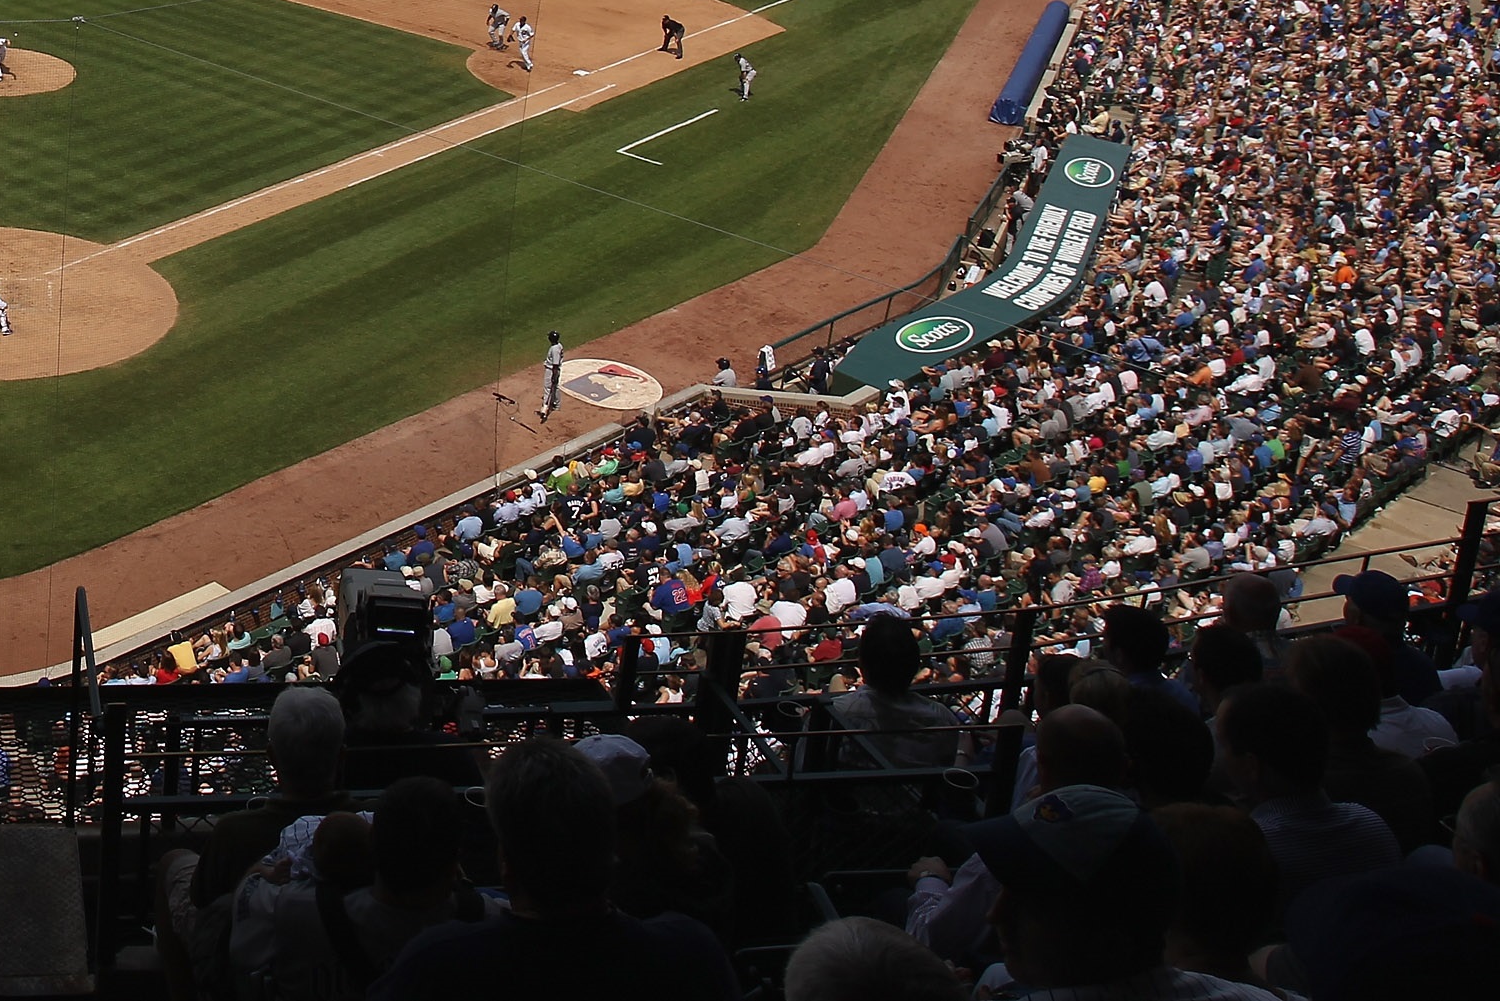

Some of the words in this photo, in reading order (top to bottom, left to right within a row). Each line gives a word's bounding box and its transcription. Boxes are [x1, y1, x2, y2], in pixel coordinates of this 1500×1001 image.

[1033, 203, 1068, 236] FRIENDLY
[1067, 210, 1097, 233] FIELD
[1027, 236, 1057, 253] THE
[1055, 228, 1090, 264] WRIGLEY
[1021, 250, 1049, 264] TO
[1050, 261, 1077, 276] OF
[981, 261, 1043, 299] WELCOME
[1012, 273, 1072, 311] CONFINES
[571, 506, 579, 518] 7
[672, 587, 687, 605] 22
